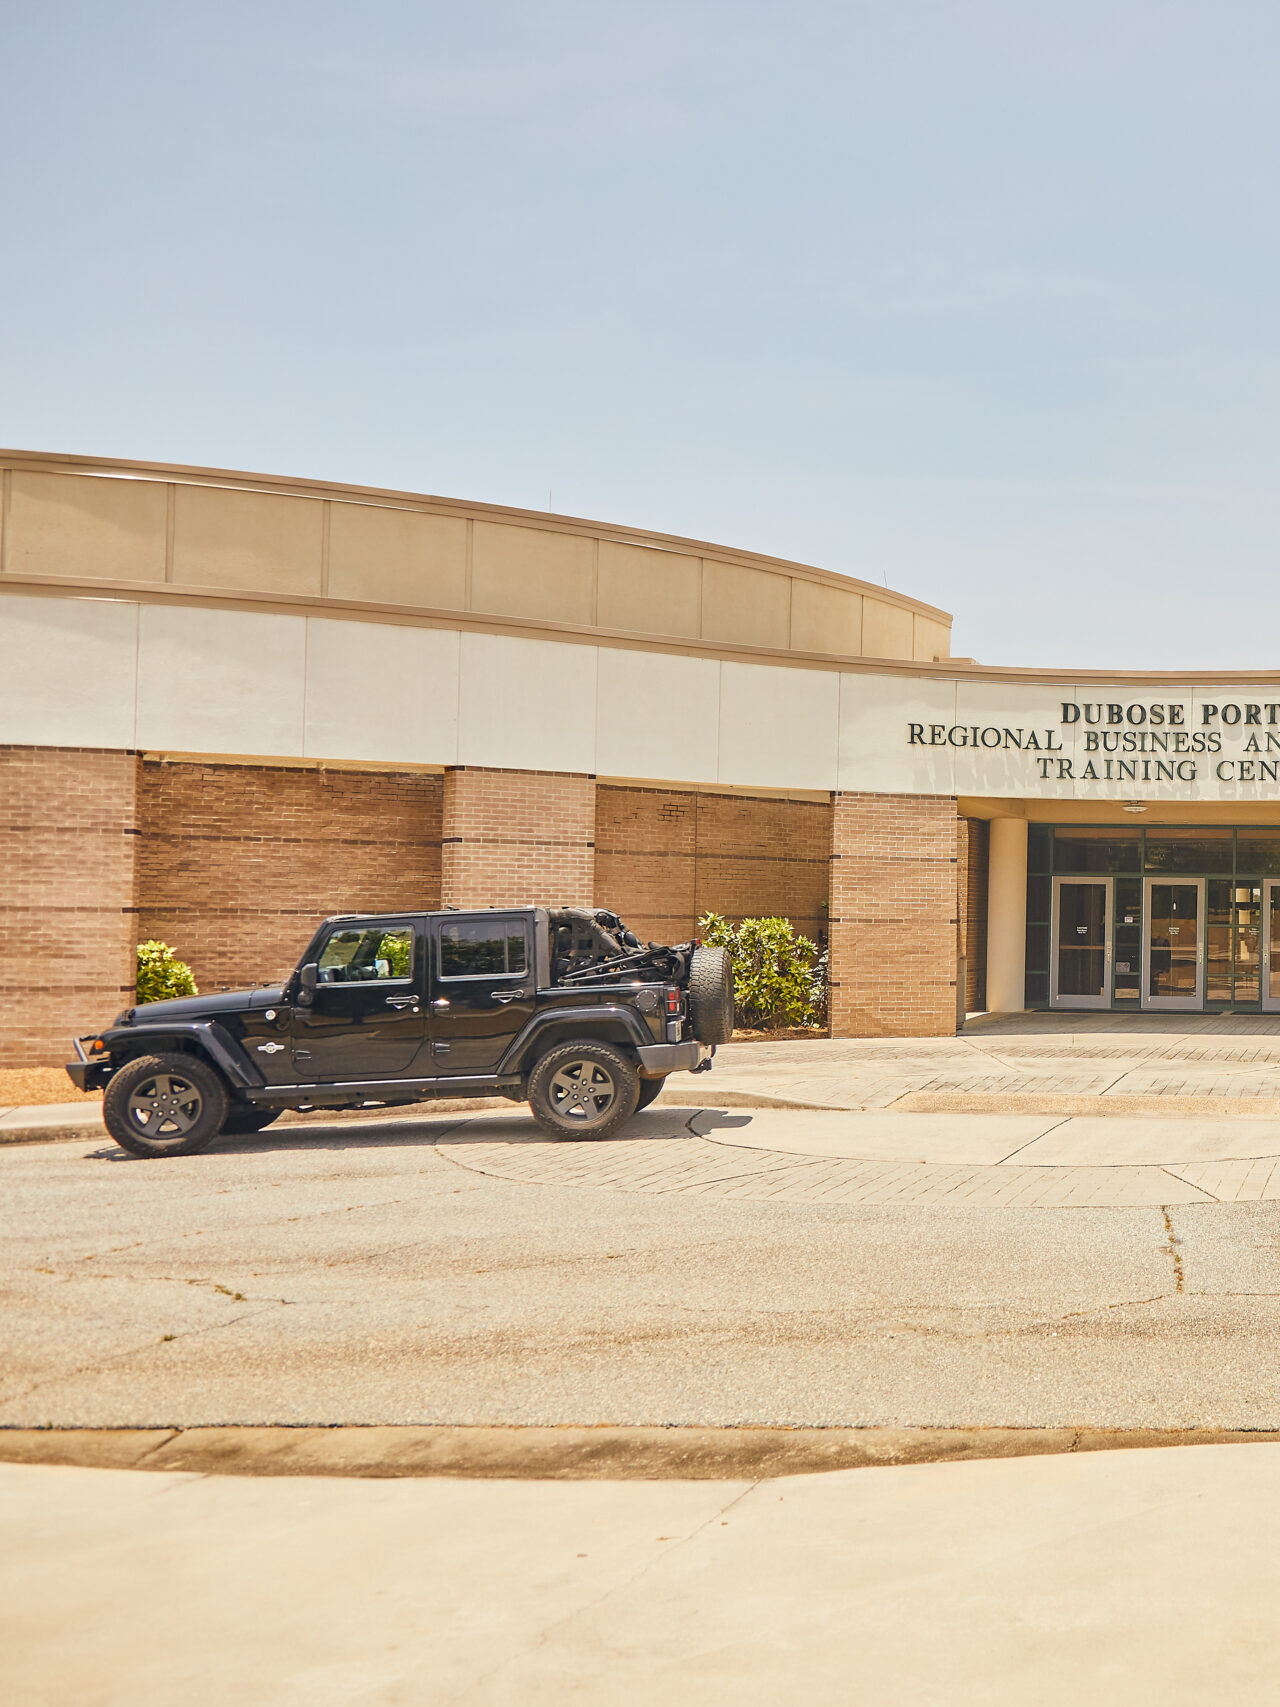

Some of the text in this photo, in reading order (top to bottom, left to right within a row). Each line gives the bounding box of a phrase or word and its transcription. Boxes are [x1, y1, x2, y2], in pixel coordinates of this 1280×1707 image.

[1060, 703, 1184, 726] DUBOSE
[907, 723, 1063, 751] REGIONAL
[1084, 731, 1222, 753] BUSINESS
[1037, 757, 1198, 782] TRAINING
